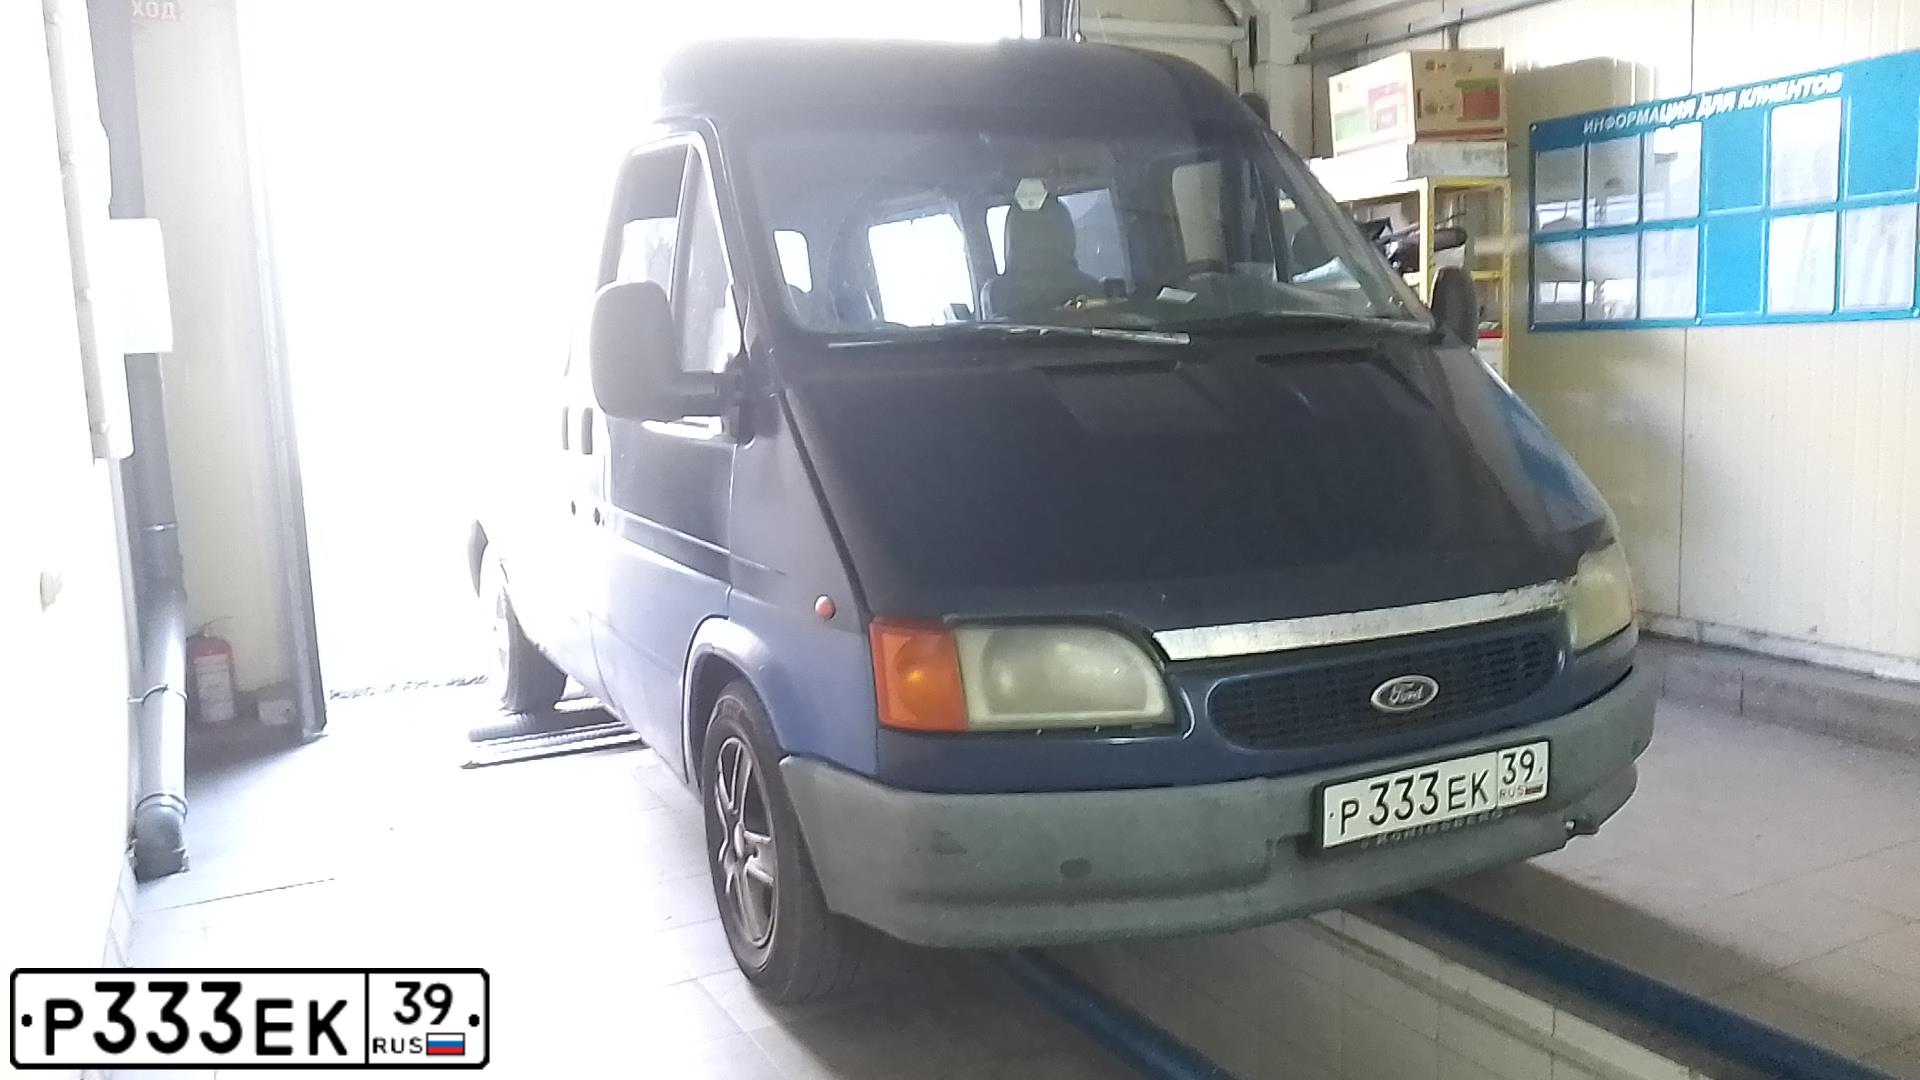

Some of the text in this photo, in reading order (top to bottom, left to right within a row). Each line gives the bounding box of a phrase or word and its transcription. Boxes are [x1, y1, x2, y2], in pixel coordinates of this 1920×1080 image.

[1583, 71, 1843, 134] ИНФОРМАЦИЯ ДЛЯ КЛИЕНТОВ
[1388, 682, 1424, 706] Ford
[1502, 749, 1535, 785] 39
[1500, 785, 1526, 798] RUS
